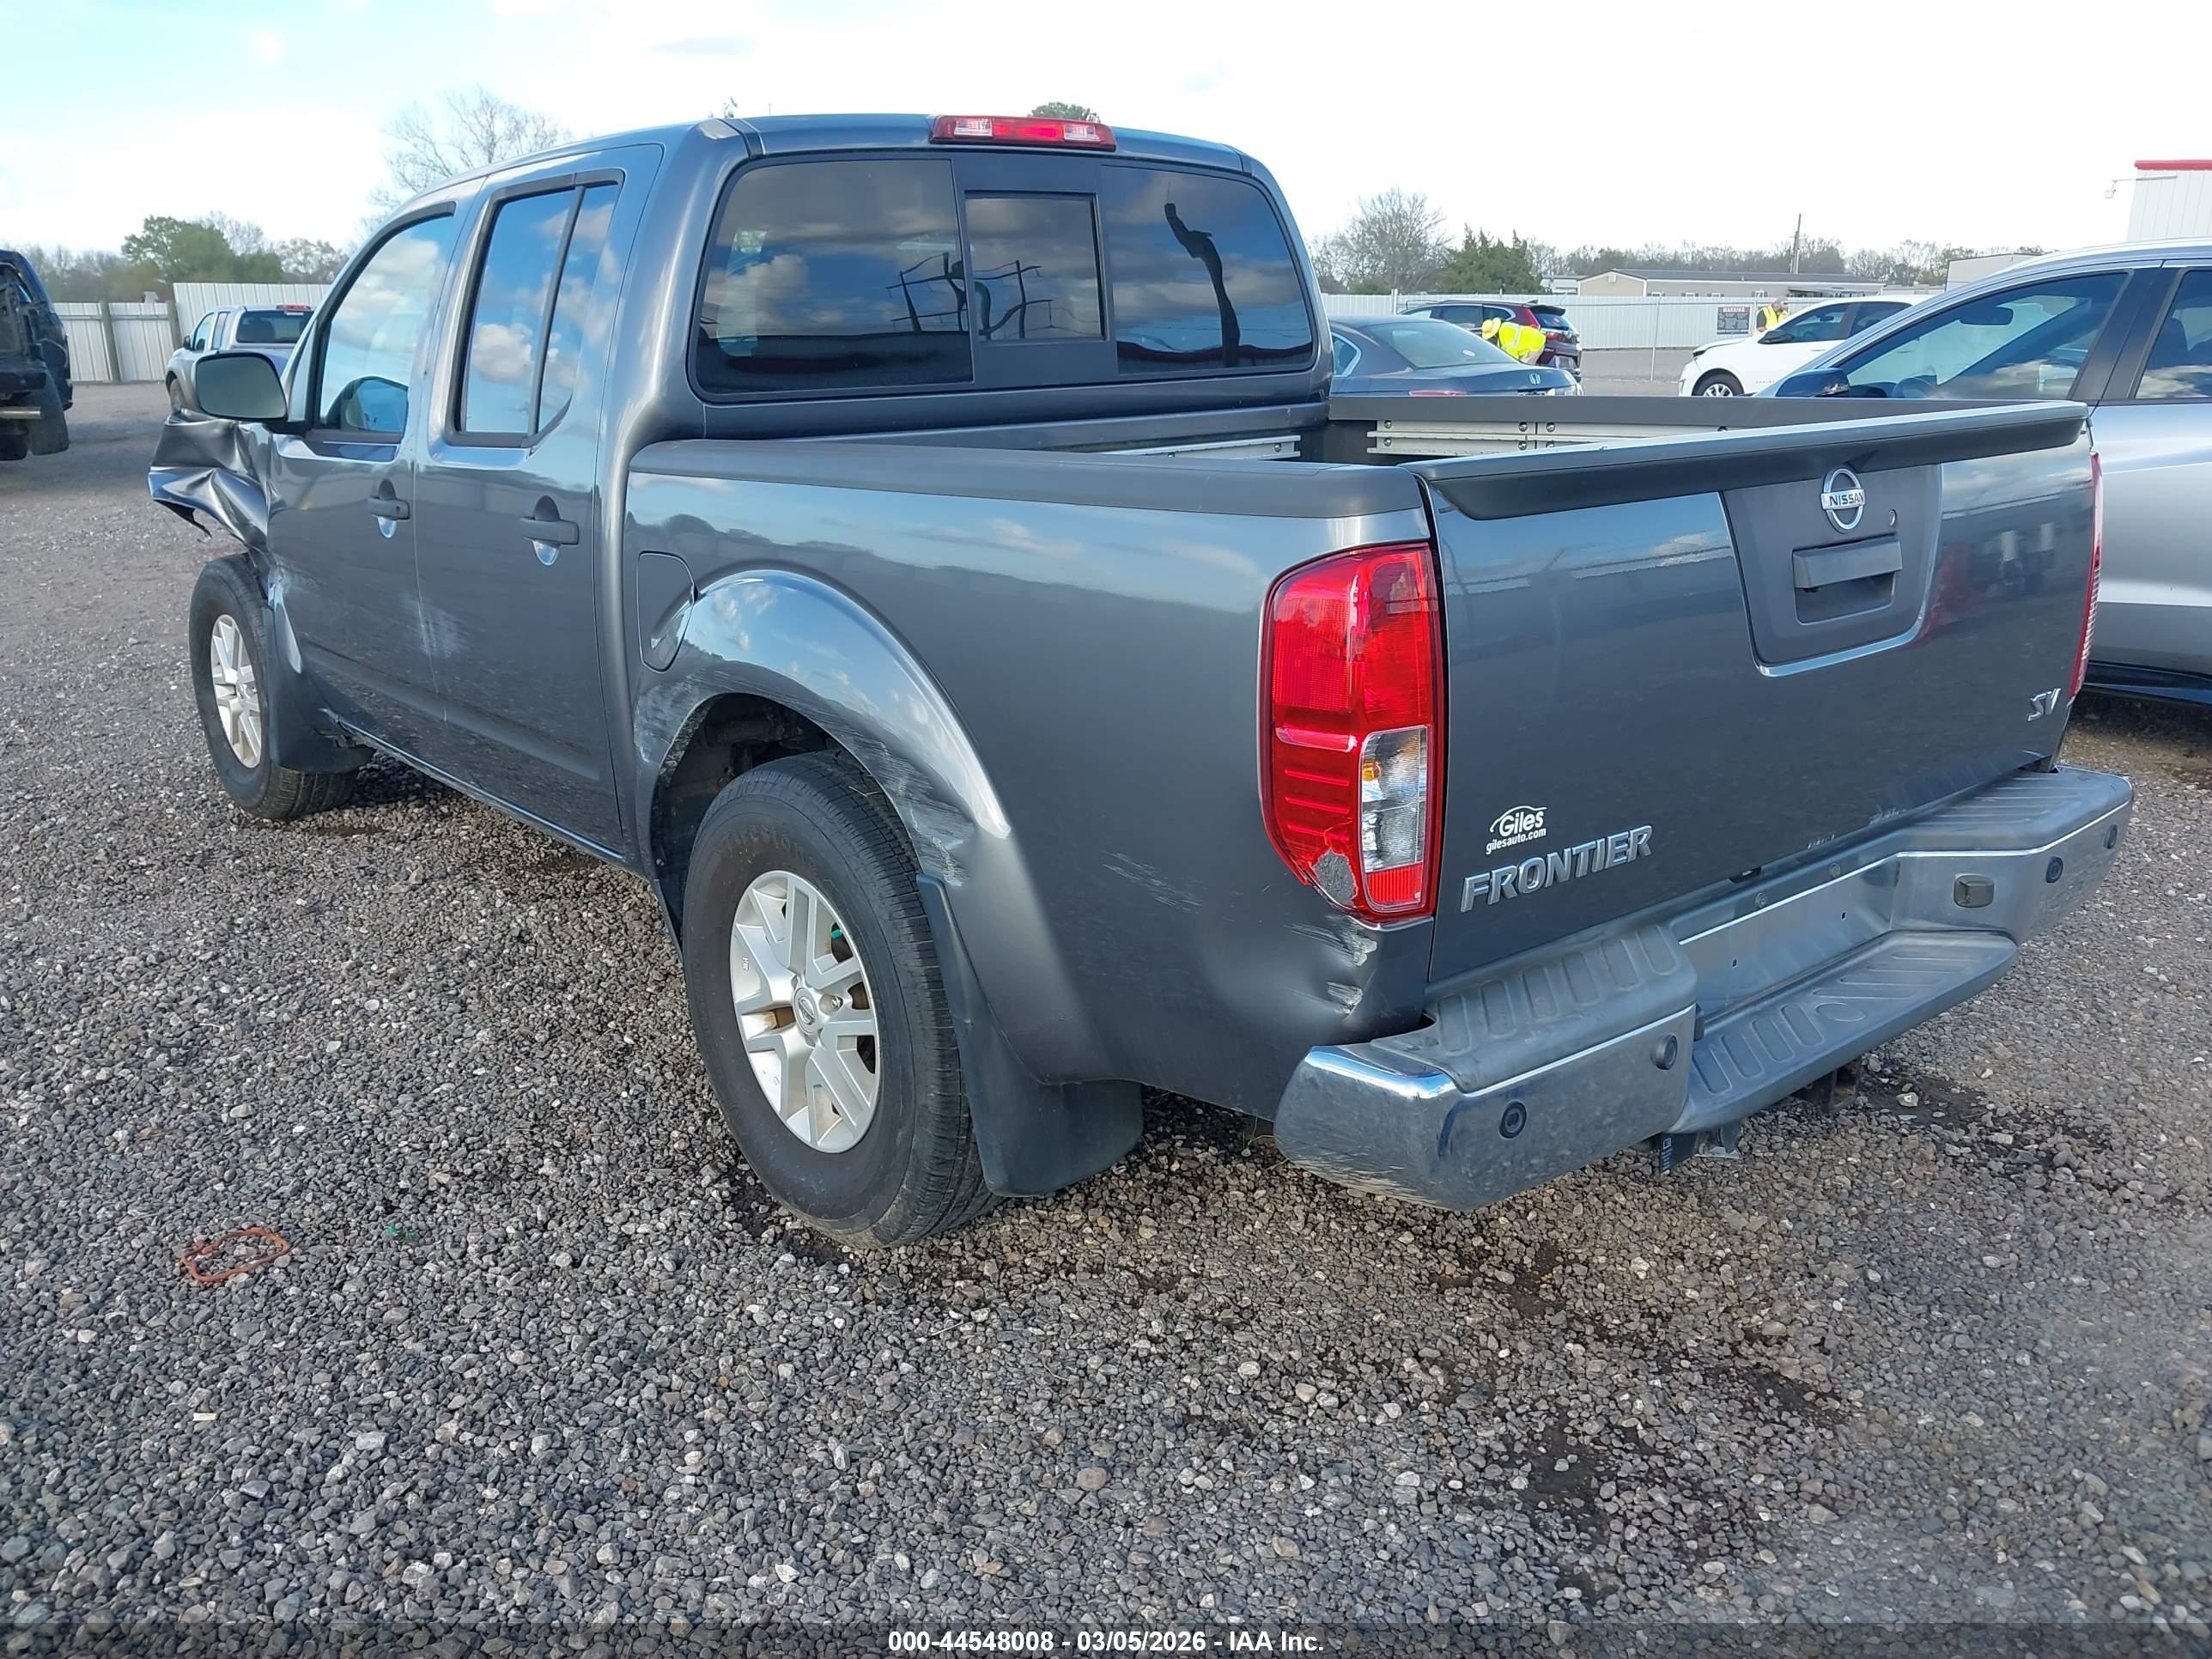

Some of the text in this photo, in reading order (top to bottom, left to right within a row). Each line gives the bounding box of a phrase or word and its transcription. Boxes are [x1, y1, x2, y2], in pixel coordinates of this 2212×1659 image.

[1829, 492, 1864, 507] NISSAN
[2027, 688, 2062, 722] SV
[1498, 809, 1545, 837] Giles
[1486, 827, 1547, 855] gilesauto.com
[1460, 824, 1653, 914] FRONTIER
